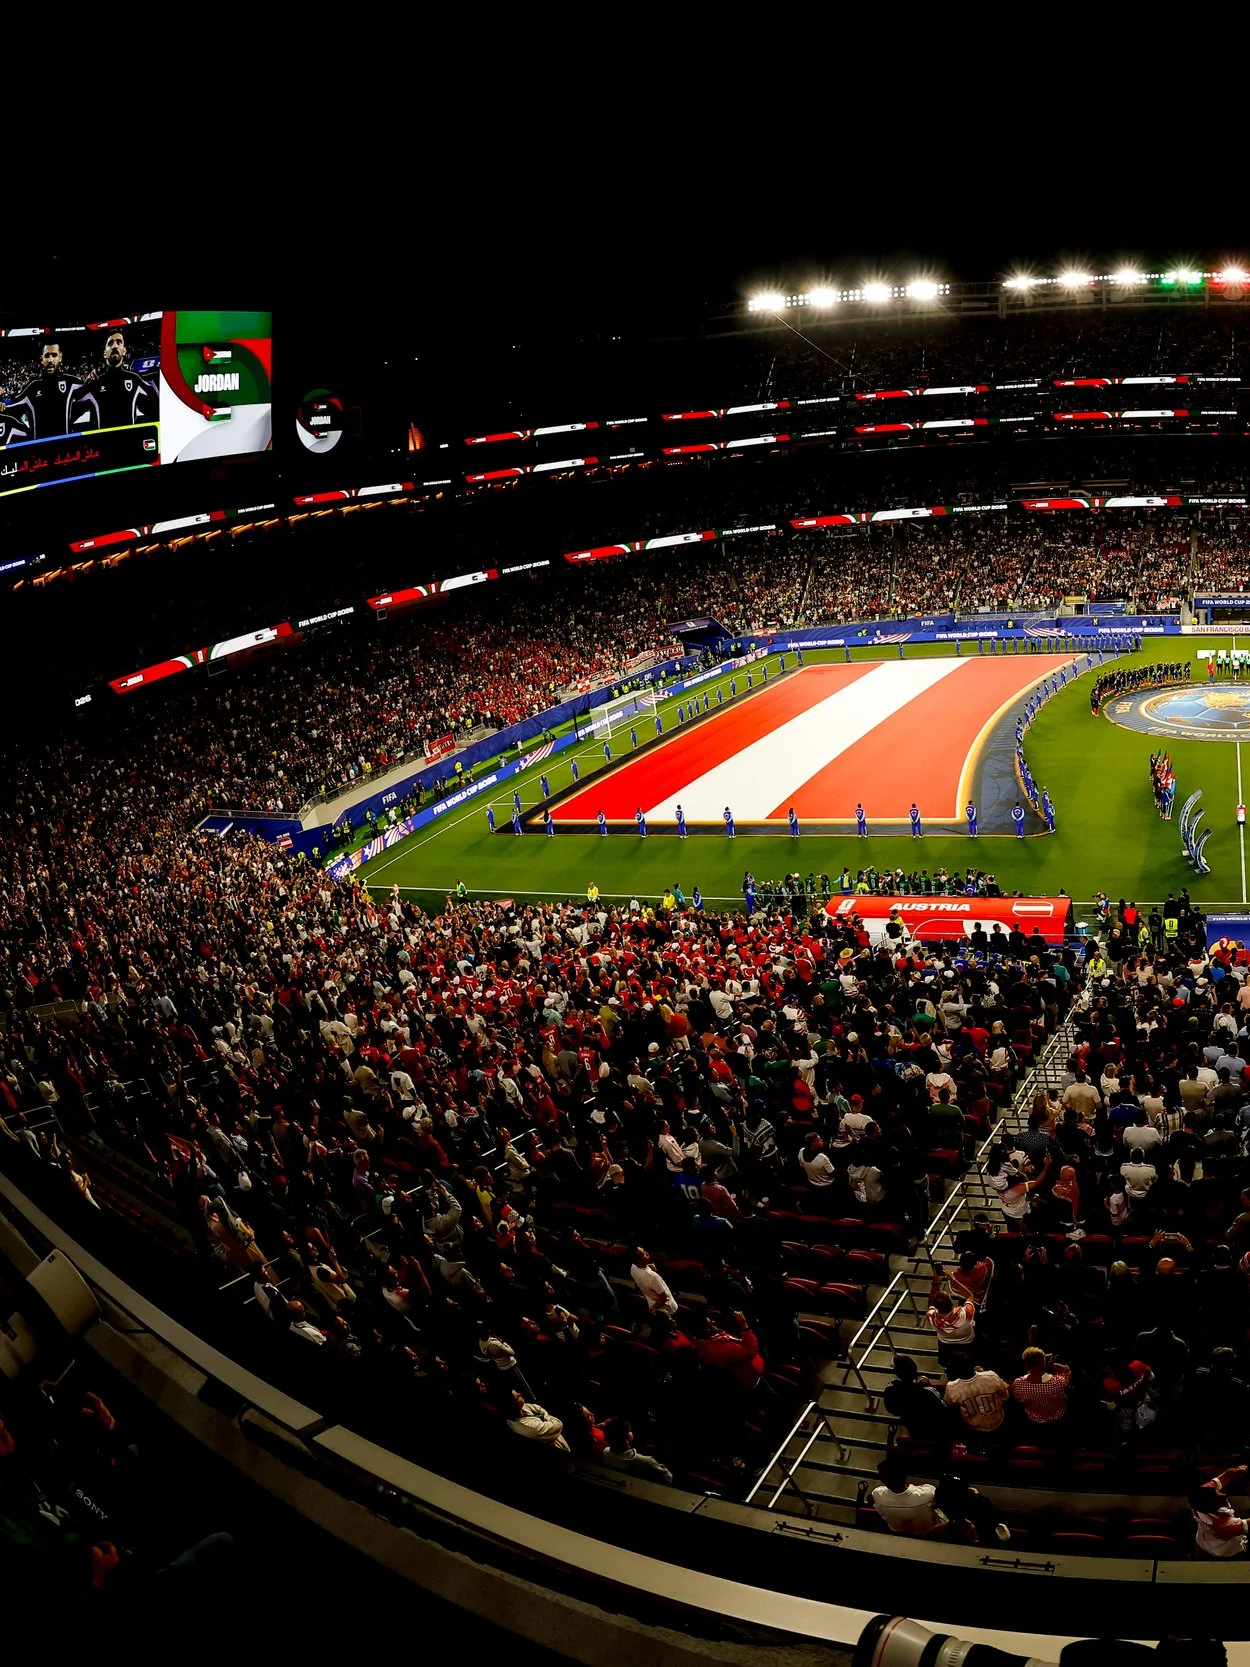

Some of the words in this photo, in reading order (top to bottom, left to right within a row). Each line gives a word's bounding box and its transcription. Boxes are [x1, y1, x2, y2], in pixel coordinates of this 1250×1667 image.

[194, 373, 239, 393] JORDAN
[310, 416, 331, 425] JORDAN
[298, 618, 310, 627] FIFA
[309, 614, 328, 624] WORLD
[327, 611, 337, 620] CUP
[337, 607, 354, 617] 2026
[1148, 726, 1177, 734] FIFA
[382, 791, 397, 804] FIFA
[433, 801, 446, 815] FIFA
[445, 789, 468, 809] WORLD
[466, 784, 478, 798] CUP
[477, 774, 497, 791] 2026
[889, 902, 971, 912] AUSTRIA
[583, 1060, 591, 1071] 6
[680, 1183, 700, 1200] 10
[962, 1392, 995, 1416] 10
[76, 1488, 109, 1520] SONY
